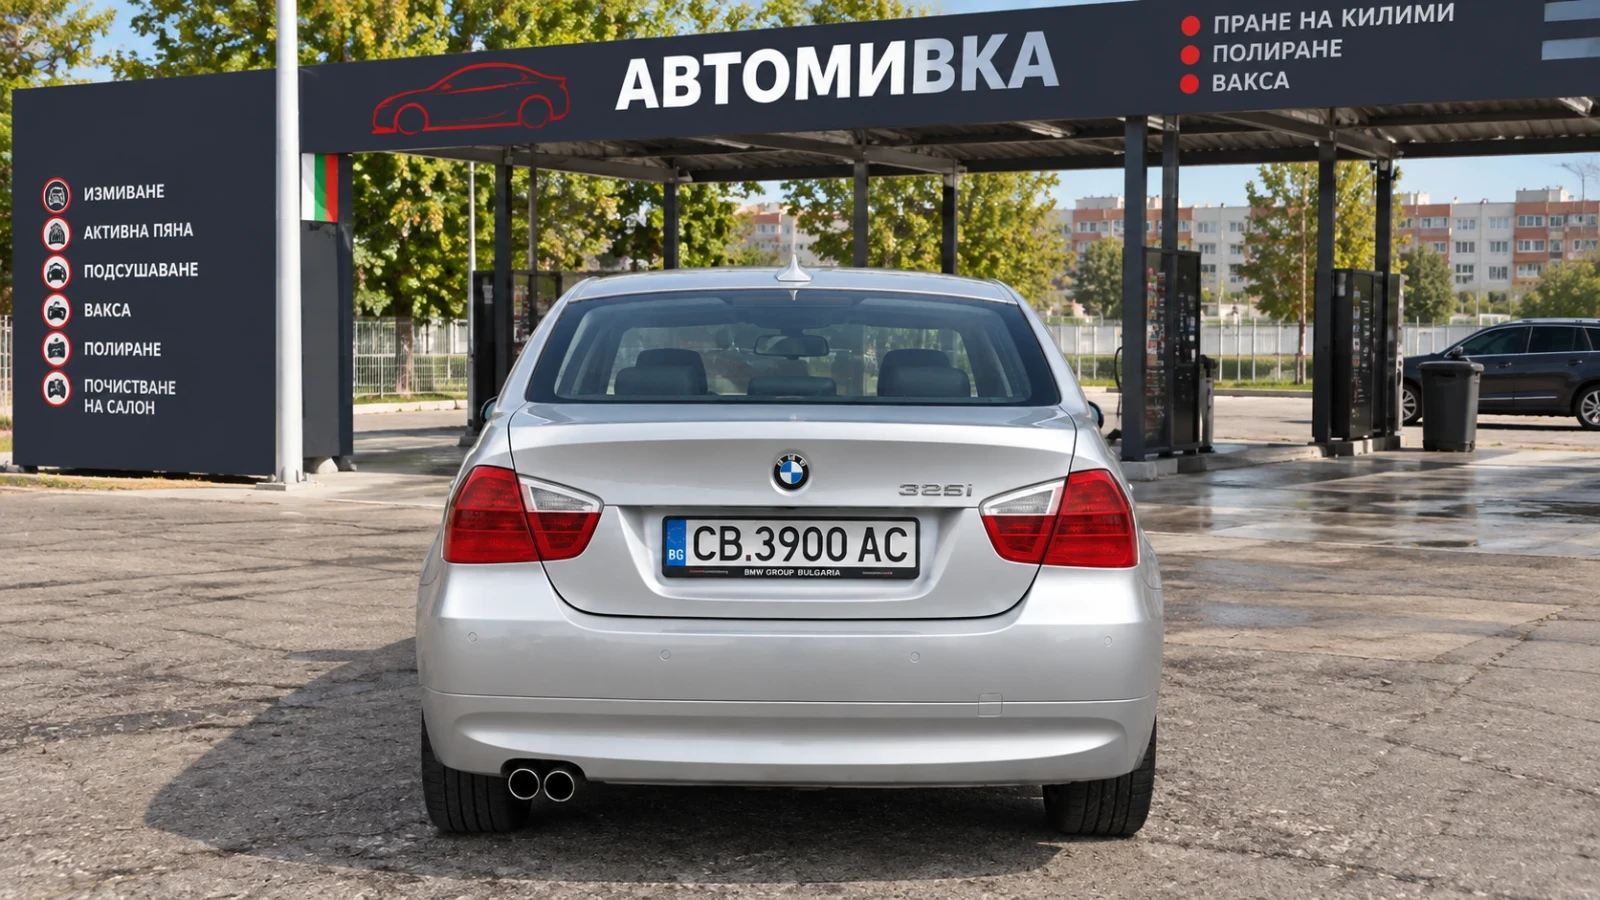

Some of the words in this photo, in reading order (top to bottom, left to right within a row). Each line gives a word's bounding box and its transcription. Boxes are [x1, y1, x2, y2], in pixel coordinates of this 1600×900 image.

[1214, 12, 1292, 34] ПРАНЕ
[1300, 10, 1333, 30] НА
[1341, 3, 1455, 28] КИЛИМИ
[1213, 39, 1343, 63] ПОЛИРАНЕ
[615, 31, 1060, 111] АВТОМИВКА
[1212, 71, 1290, 92] ВАКСА
[84, 184, 165, 201] ИЗМИВАНЕ
[84, 224, 149, 240] АКТИВНА
[153, 222, 194, 238] ПЯНА
[84, 262, 199, 280] ПОДСУШАВАНЕ
[84, 303, 131, 317] ВАКСА
[84, 342, 161, 357] ПОЛИРАНЕ
[84, 379, 176, 395] ПОЧИСТВАНЕ
[84, 399, 103, 413] НА
[107, 400, 155, 415] САЛОН
[899, 483, 973, 497] 325i
[858, 526, 908, 562] AC
[668, 549, 684, 560] BG
